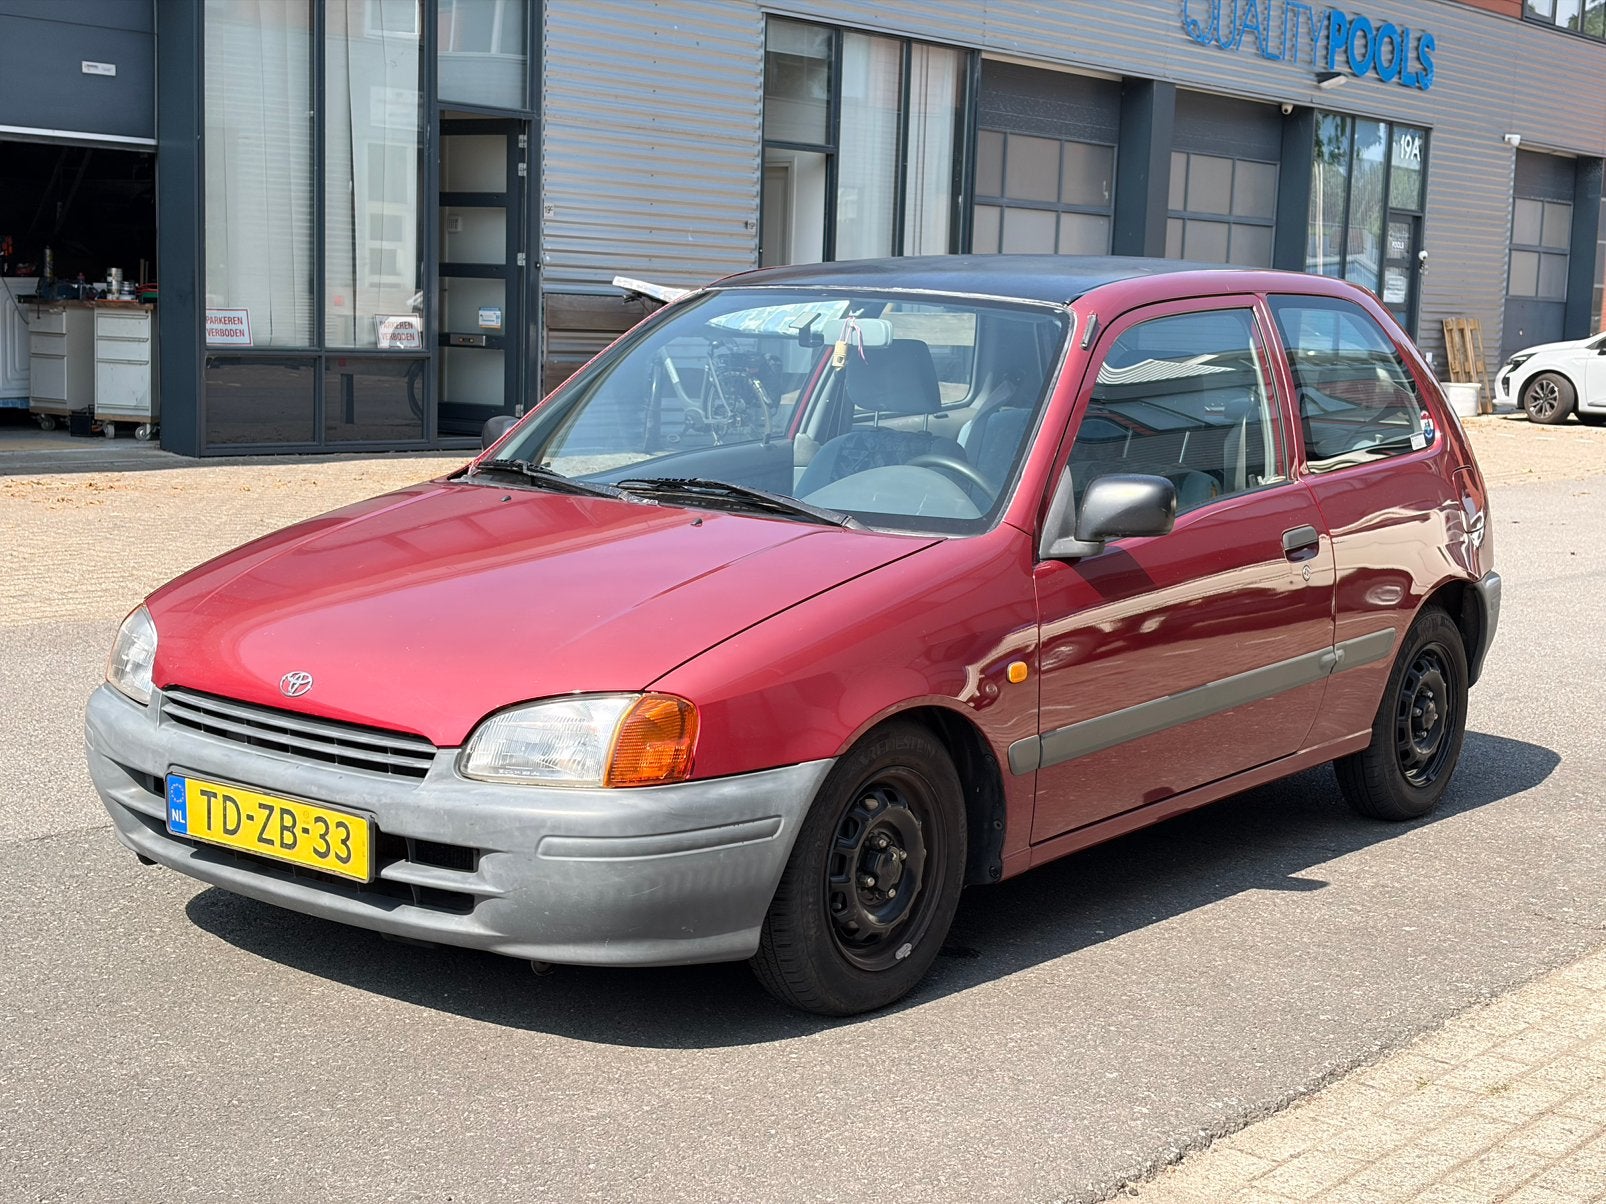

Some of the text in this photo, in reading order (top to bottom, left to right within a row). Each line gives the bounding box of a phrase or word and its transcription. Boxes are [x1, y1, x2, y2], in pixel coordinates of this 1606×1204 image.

[1400, 134, 1421, 161] 19A
[172, 808, 186, 824] NL
[199, 788, 352, 865] TD-ZB-33
